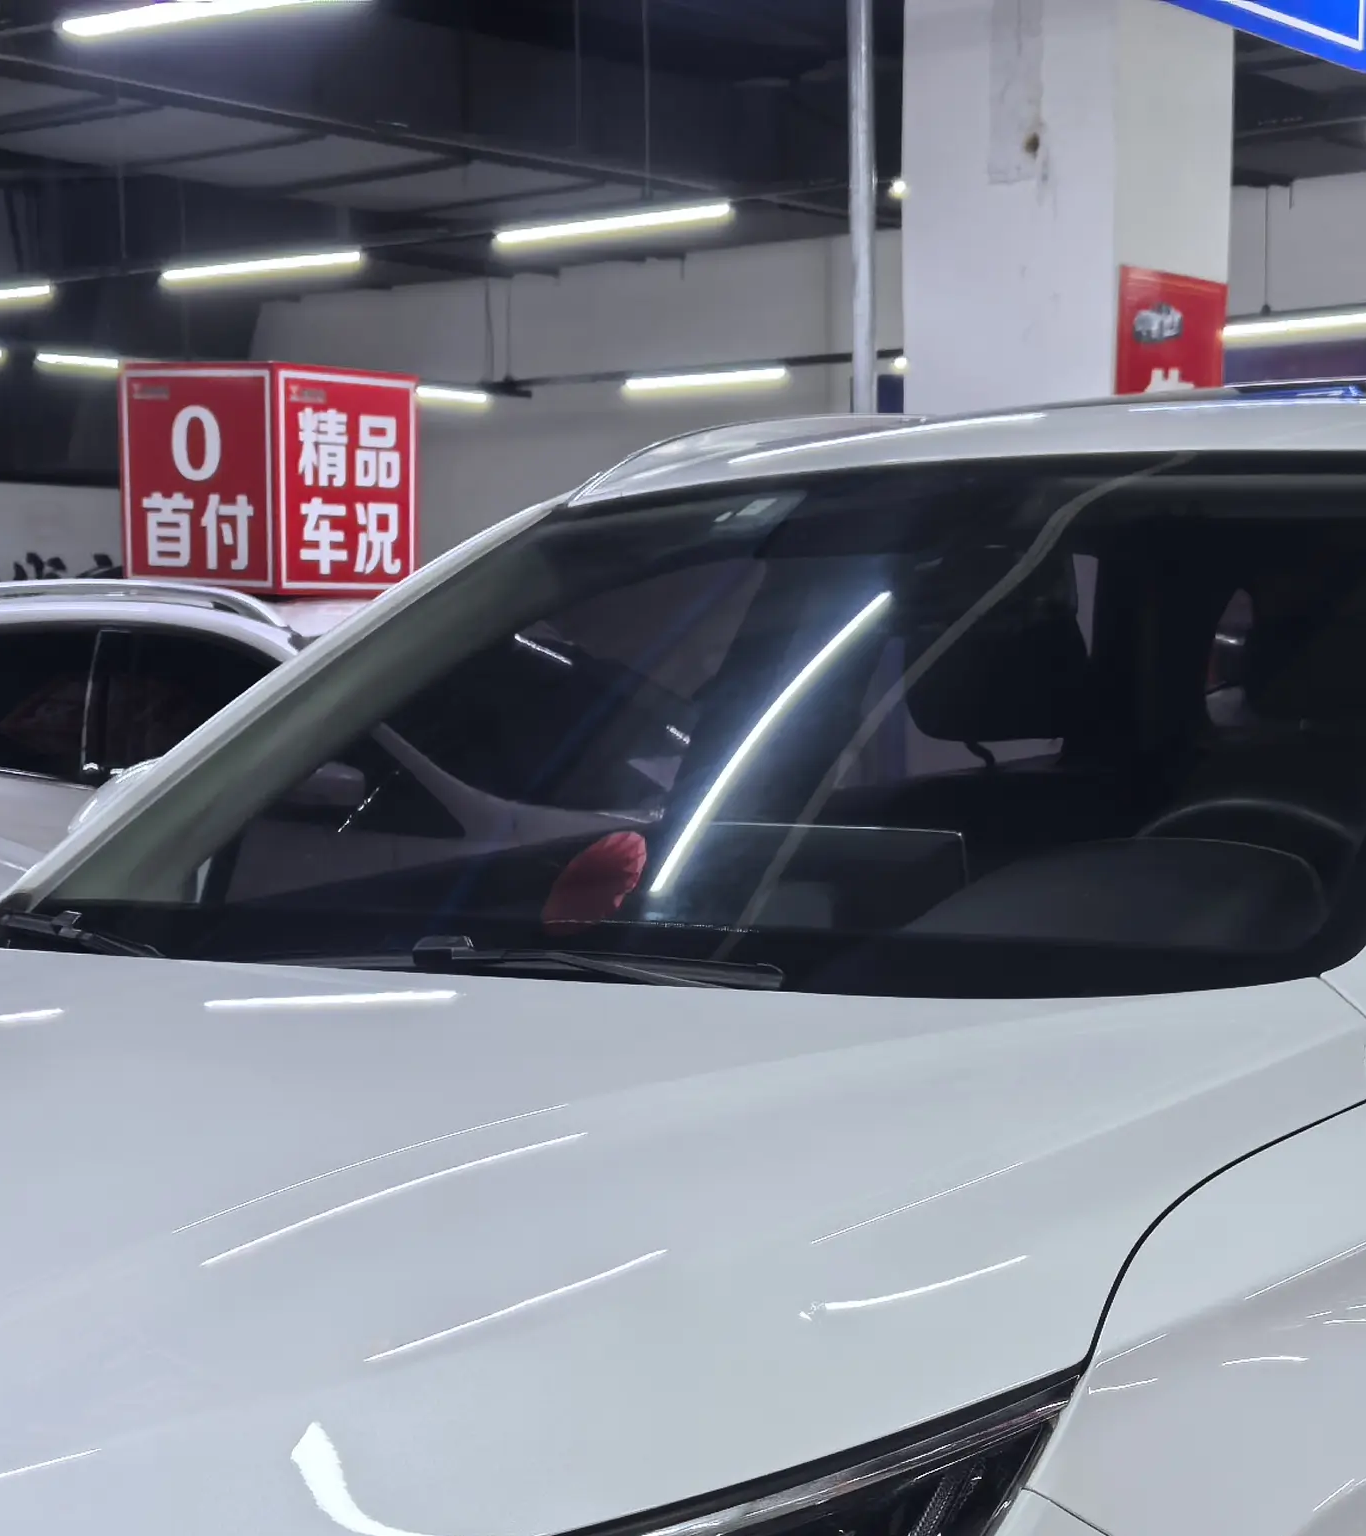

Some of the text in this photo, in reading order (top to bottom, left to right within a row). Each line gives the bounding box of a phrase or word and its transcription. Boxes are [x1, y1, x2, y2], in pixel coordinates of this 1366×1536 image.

[171, 405, 222, 482] 0
[298, 407, 401, 489] 精品
[142, 491, 254, 571] 首付
[299, 497, 402, 576] 车况
